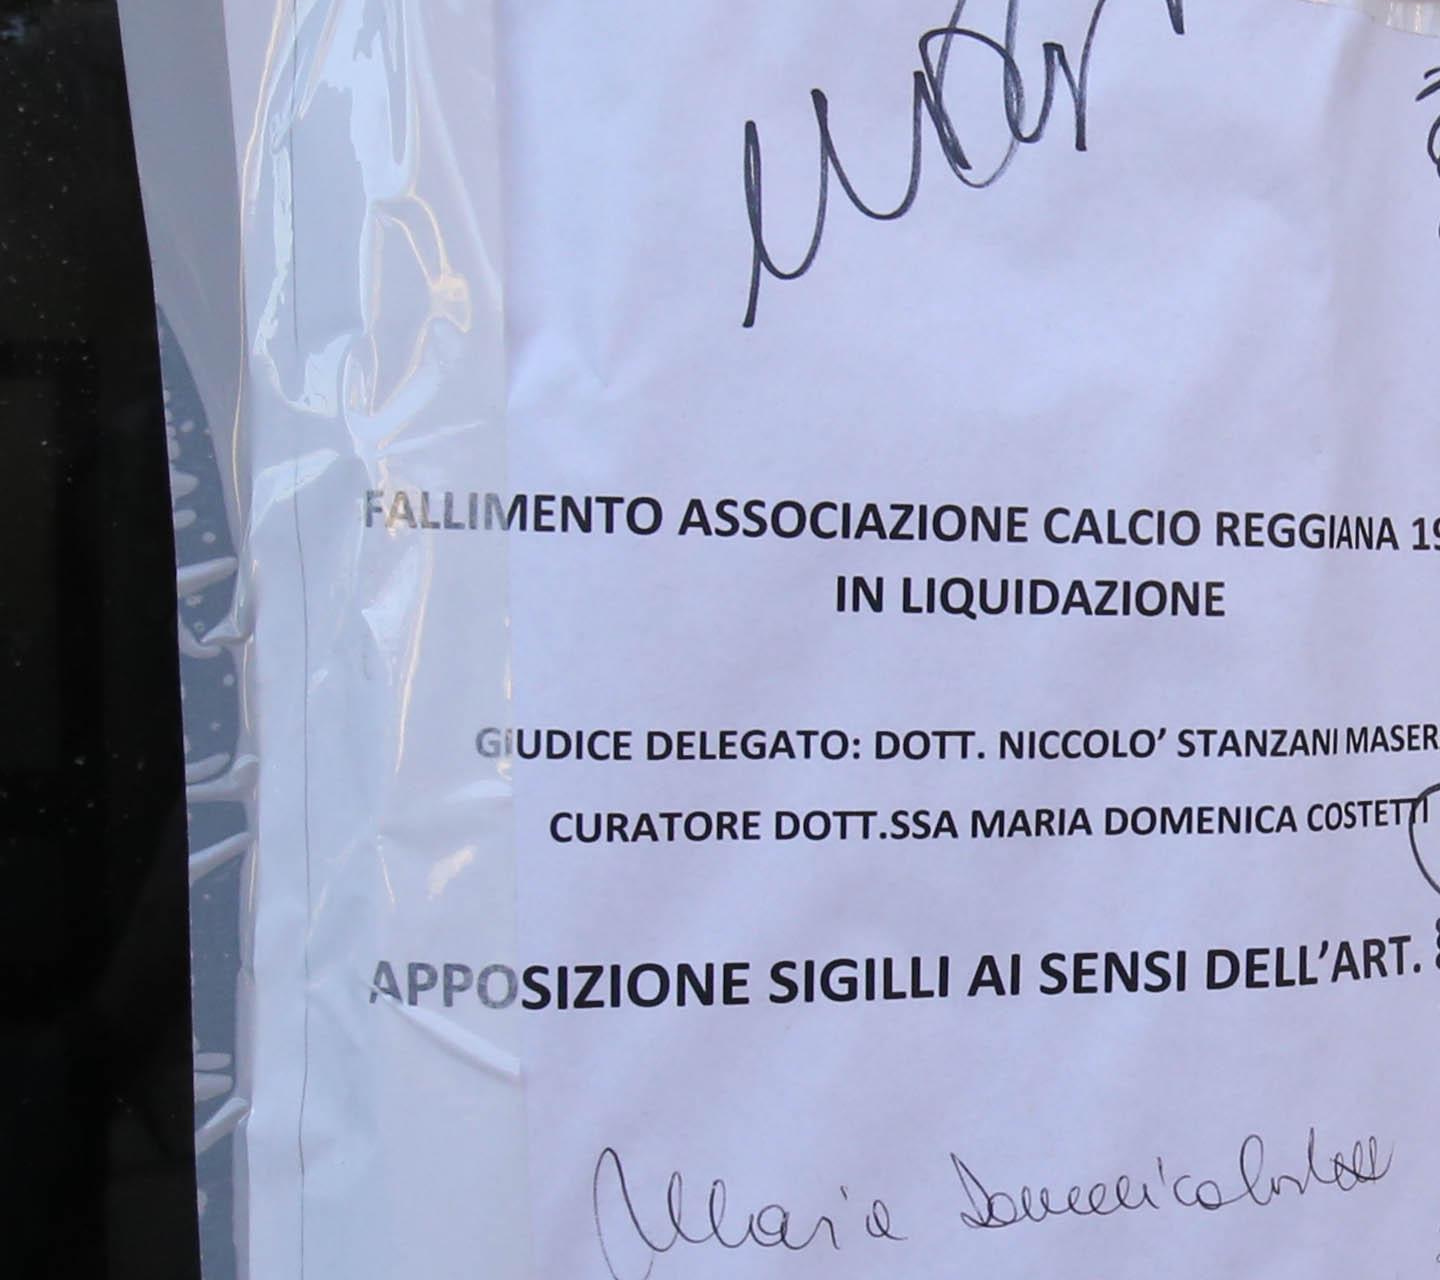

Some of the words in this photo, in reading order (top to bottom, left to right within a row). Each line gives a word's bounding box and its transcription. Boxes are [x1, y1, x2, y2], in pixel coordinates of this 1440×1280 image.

[364, 489, 663, 536] FALLIMENTO
[677, 498, 1030, 544] ASSOCIAZIONE
[1042, 506, 1202, 547] CALCIO
[1216, 511, 1400, 552] REGGIANA
[836, 575, 884, 613] IN
[901, 576, 1226, 620] LIQUIDAZIONE
[475, 727, 633, 761] GIUDICE
[646, 728, 862, 761] DELEGATO:
[874, 729, 986, 760] DOTT.
[1177, 726, 1339, 759] STANZANI
[548, 809, 761, 844] CURATORE
[774, 808, 959, 841] DOTT.SSA
[970, 806, 1093, 839] MARIA
[1103, 804, 1298, 837] DOMENICA
[1307, 795, 1428, 833] COSTETTI
[368, 959, 751, 1011] APPOSIZIONE
[768, 954, 951, 1006] SIGILLI
[967, 953, 1021, 997] AI
[1038, 949, 1187, 996] SENSI
